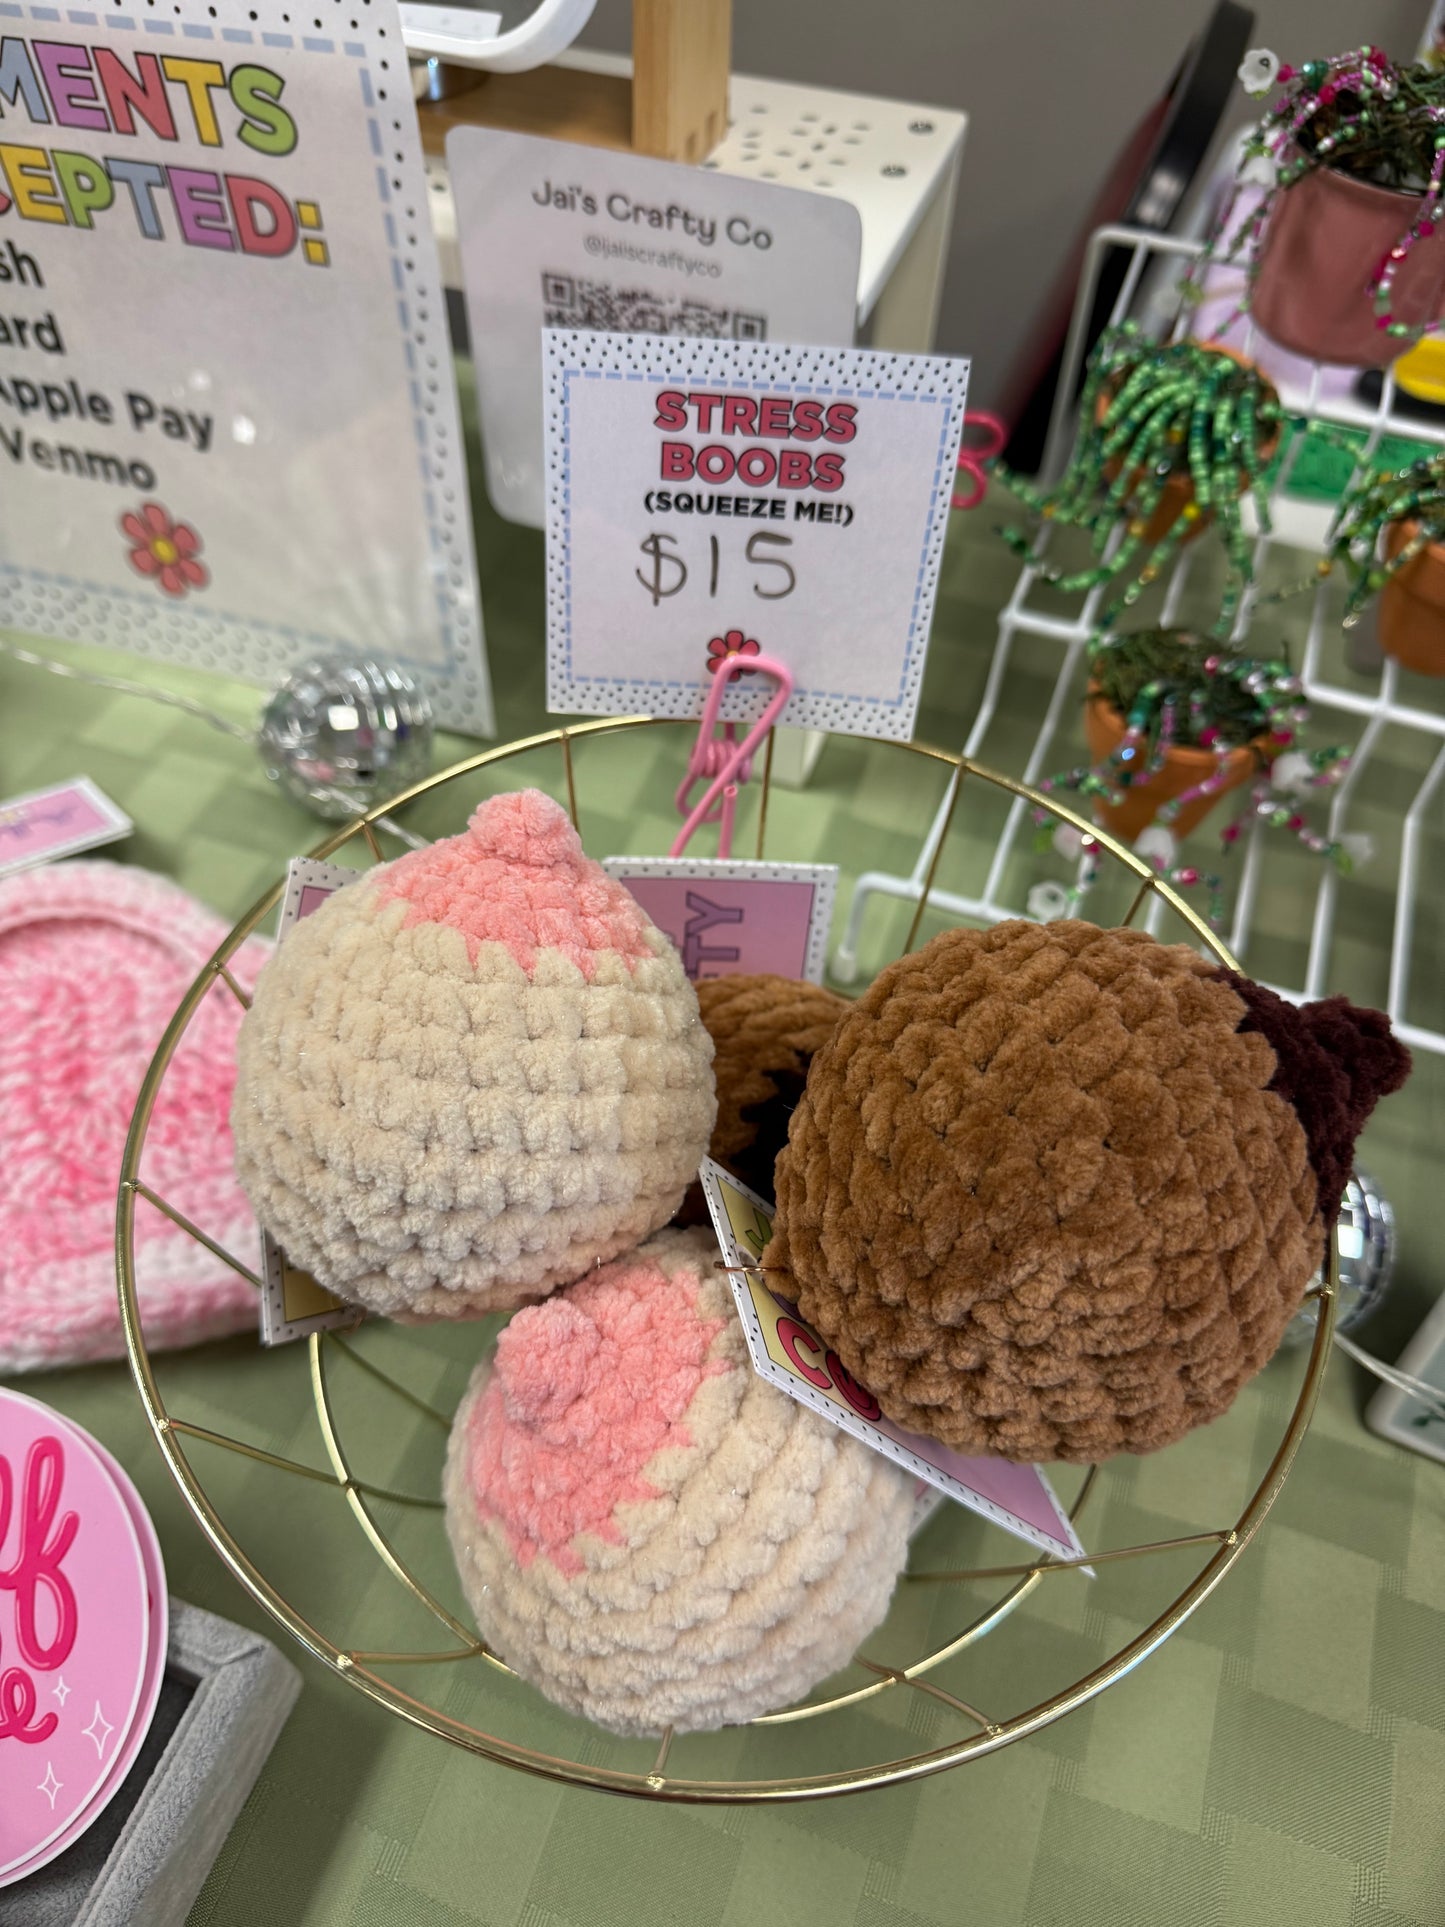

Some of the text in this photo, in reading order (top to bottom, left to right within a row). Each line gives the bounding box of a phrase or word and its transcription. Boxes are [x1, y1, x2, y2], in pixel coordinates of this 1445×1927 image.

[0, 36, 298, 156] MENTS
[0, 142, 330, 267] EPTED:
[531, 181, 773, 250] Jai's Crafty Co
[125, 388, 213, 452] Pay
[653, 391, 858, 444] STRESS
[0, 422, 157, 491] Venmo
[661, 441, 845, 492] BOOBS
[644, 491, 855, 527] (SQUEEZE ME!)
[636, 531, 795, 607] $15
